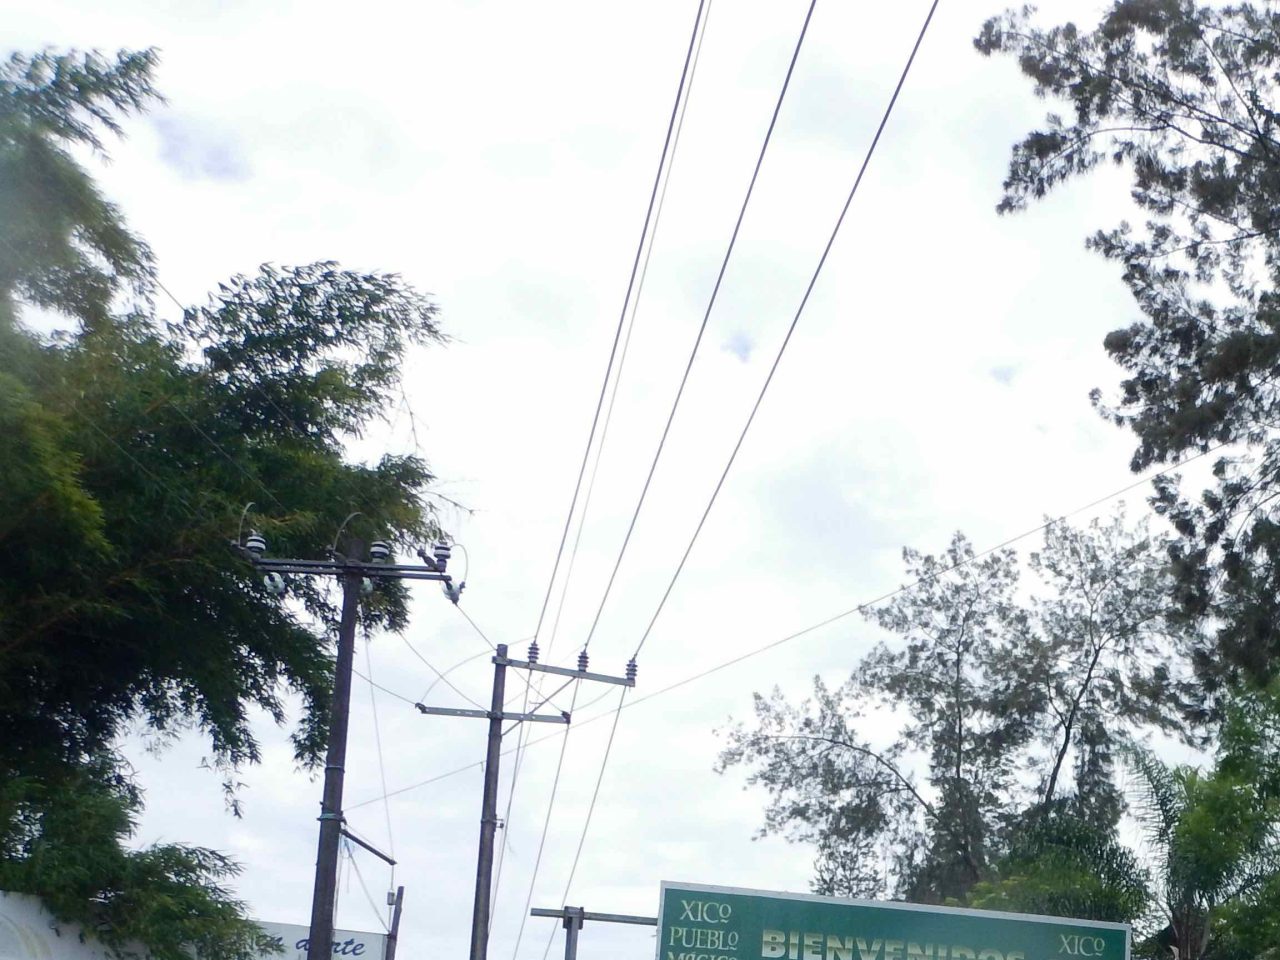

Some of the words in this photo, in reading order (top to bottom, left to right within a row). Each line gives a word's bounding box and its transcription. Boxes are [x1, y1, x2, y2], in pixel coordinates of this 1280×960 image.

[679, 899, 733, 925] XICO
[668, 926, 740, 951] PUEBLO
[1058, 934, 1106, 957] XICO
